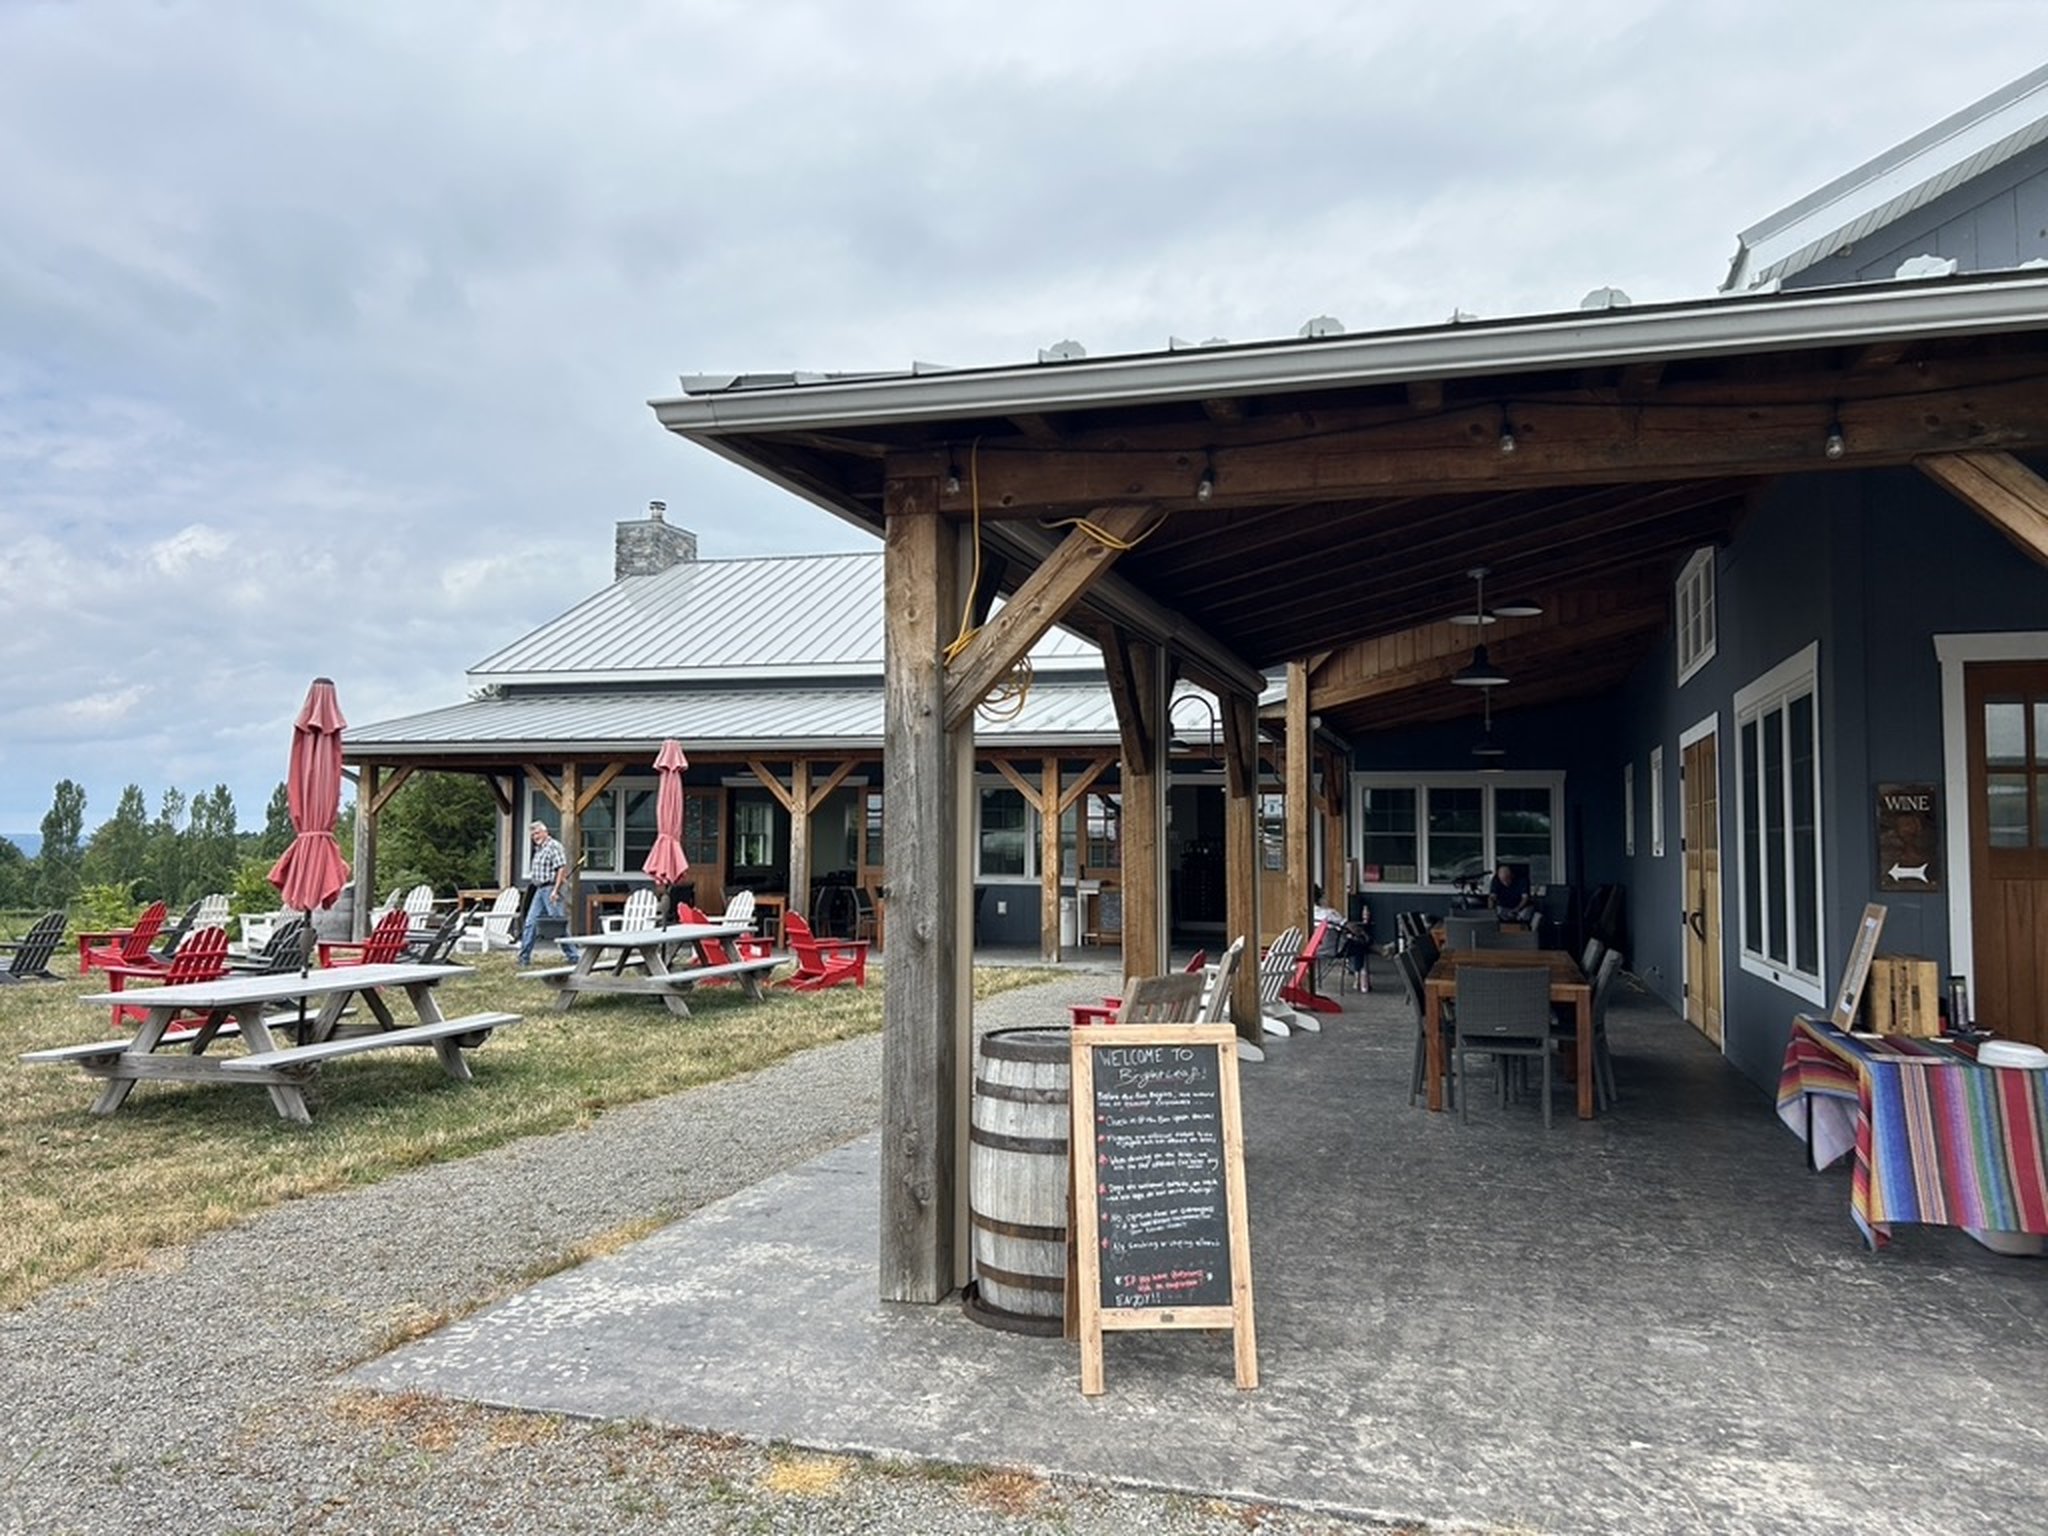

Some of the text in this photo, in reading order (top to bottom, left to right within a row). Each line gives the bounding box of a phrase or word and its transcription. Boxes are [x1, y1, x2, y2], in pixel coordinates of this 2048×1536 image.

[1884, 796, 1930, 811] WINE
[1099, 1048, 1194, 1066] WELCOME TO
